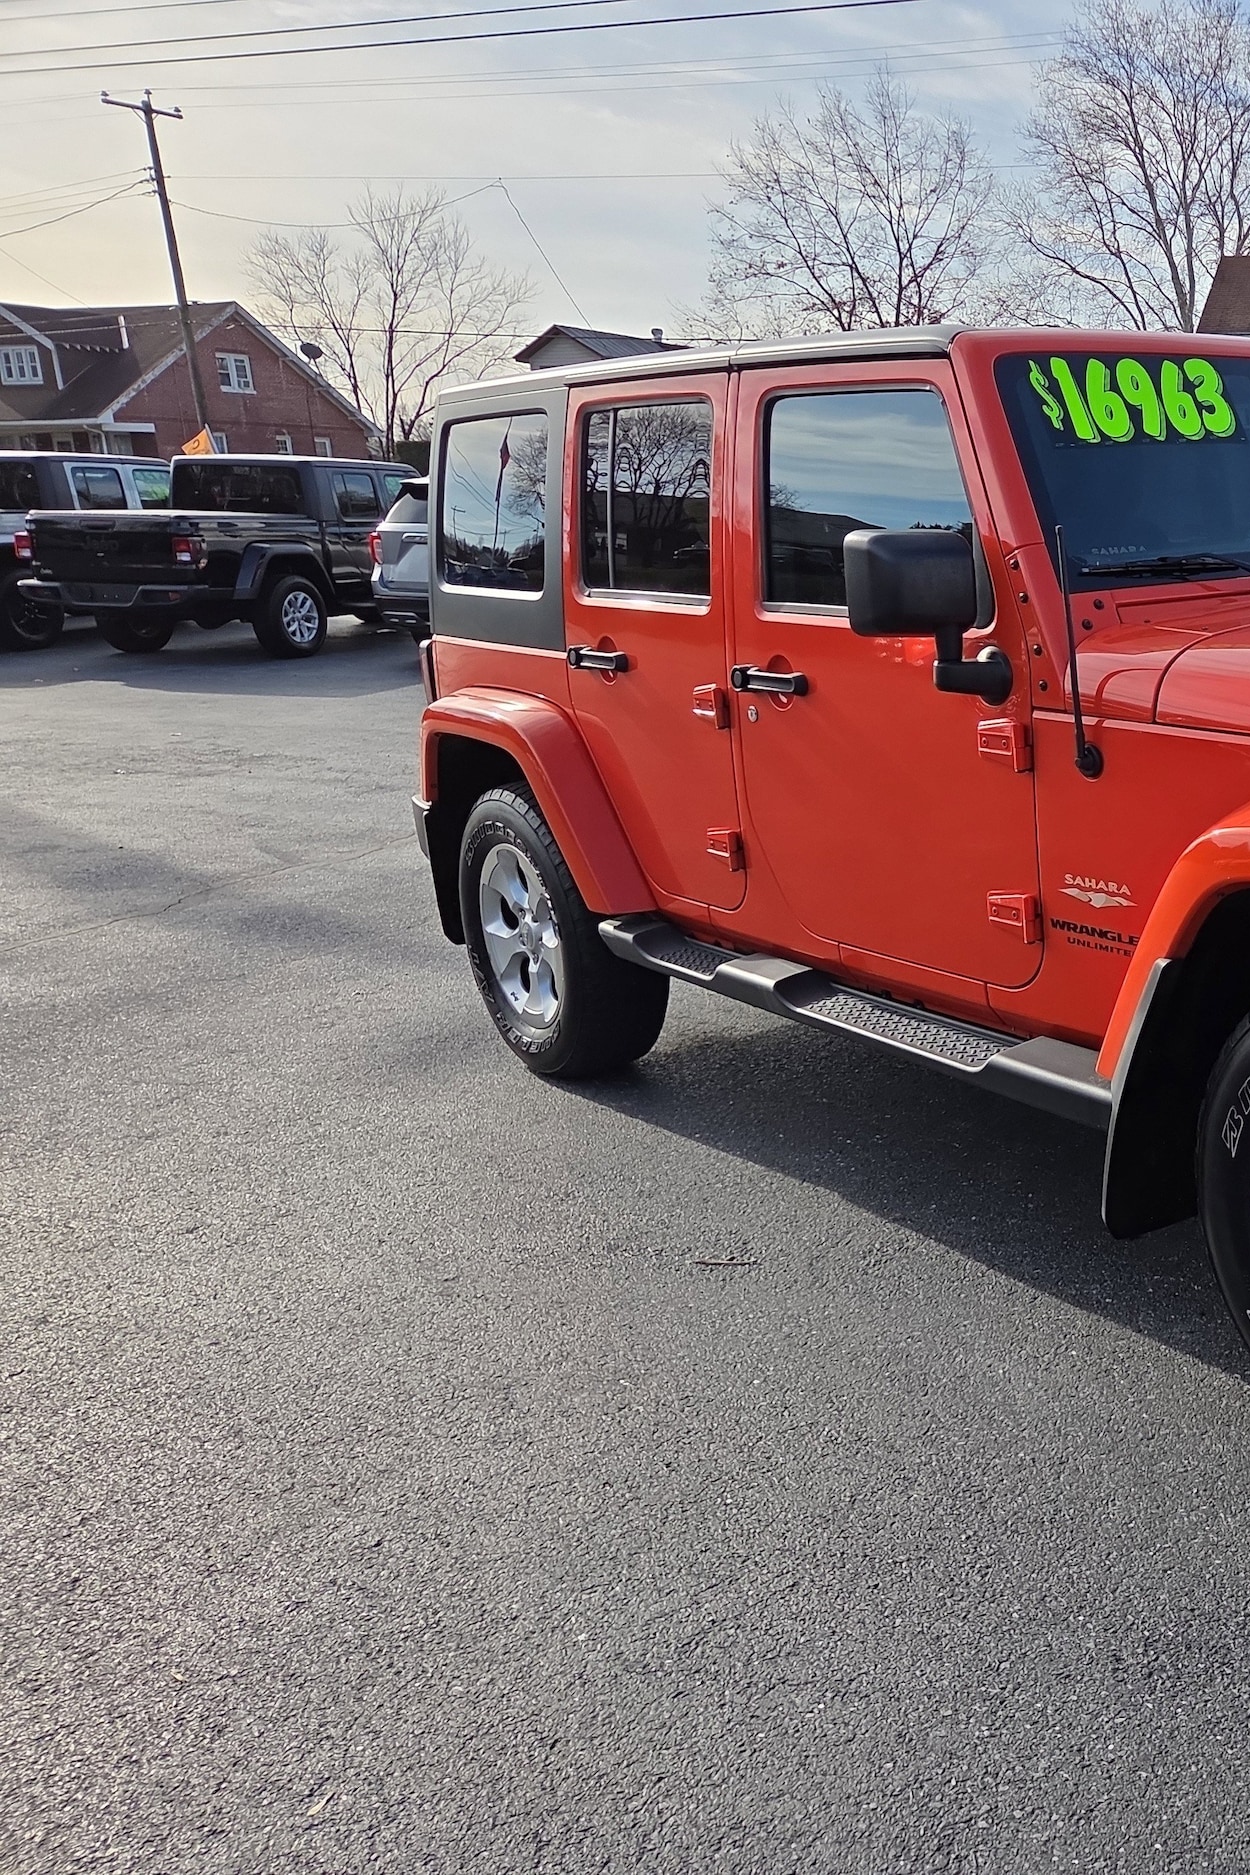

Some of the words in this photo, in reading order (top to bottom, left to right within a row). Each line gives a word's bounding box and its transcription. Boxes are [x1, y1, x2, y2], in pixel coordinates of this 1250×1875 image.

[1028, 356, 1237, 444] $16963
[1091, 545, 1148, 555] SAHARA
[1064, 873, 1131, 896] SAHARA
[1050, 917, 1139, 945] WRANGLE
[1067, 936, 1133, 957] UNLIMITE
